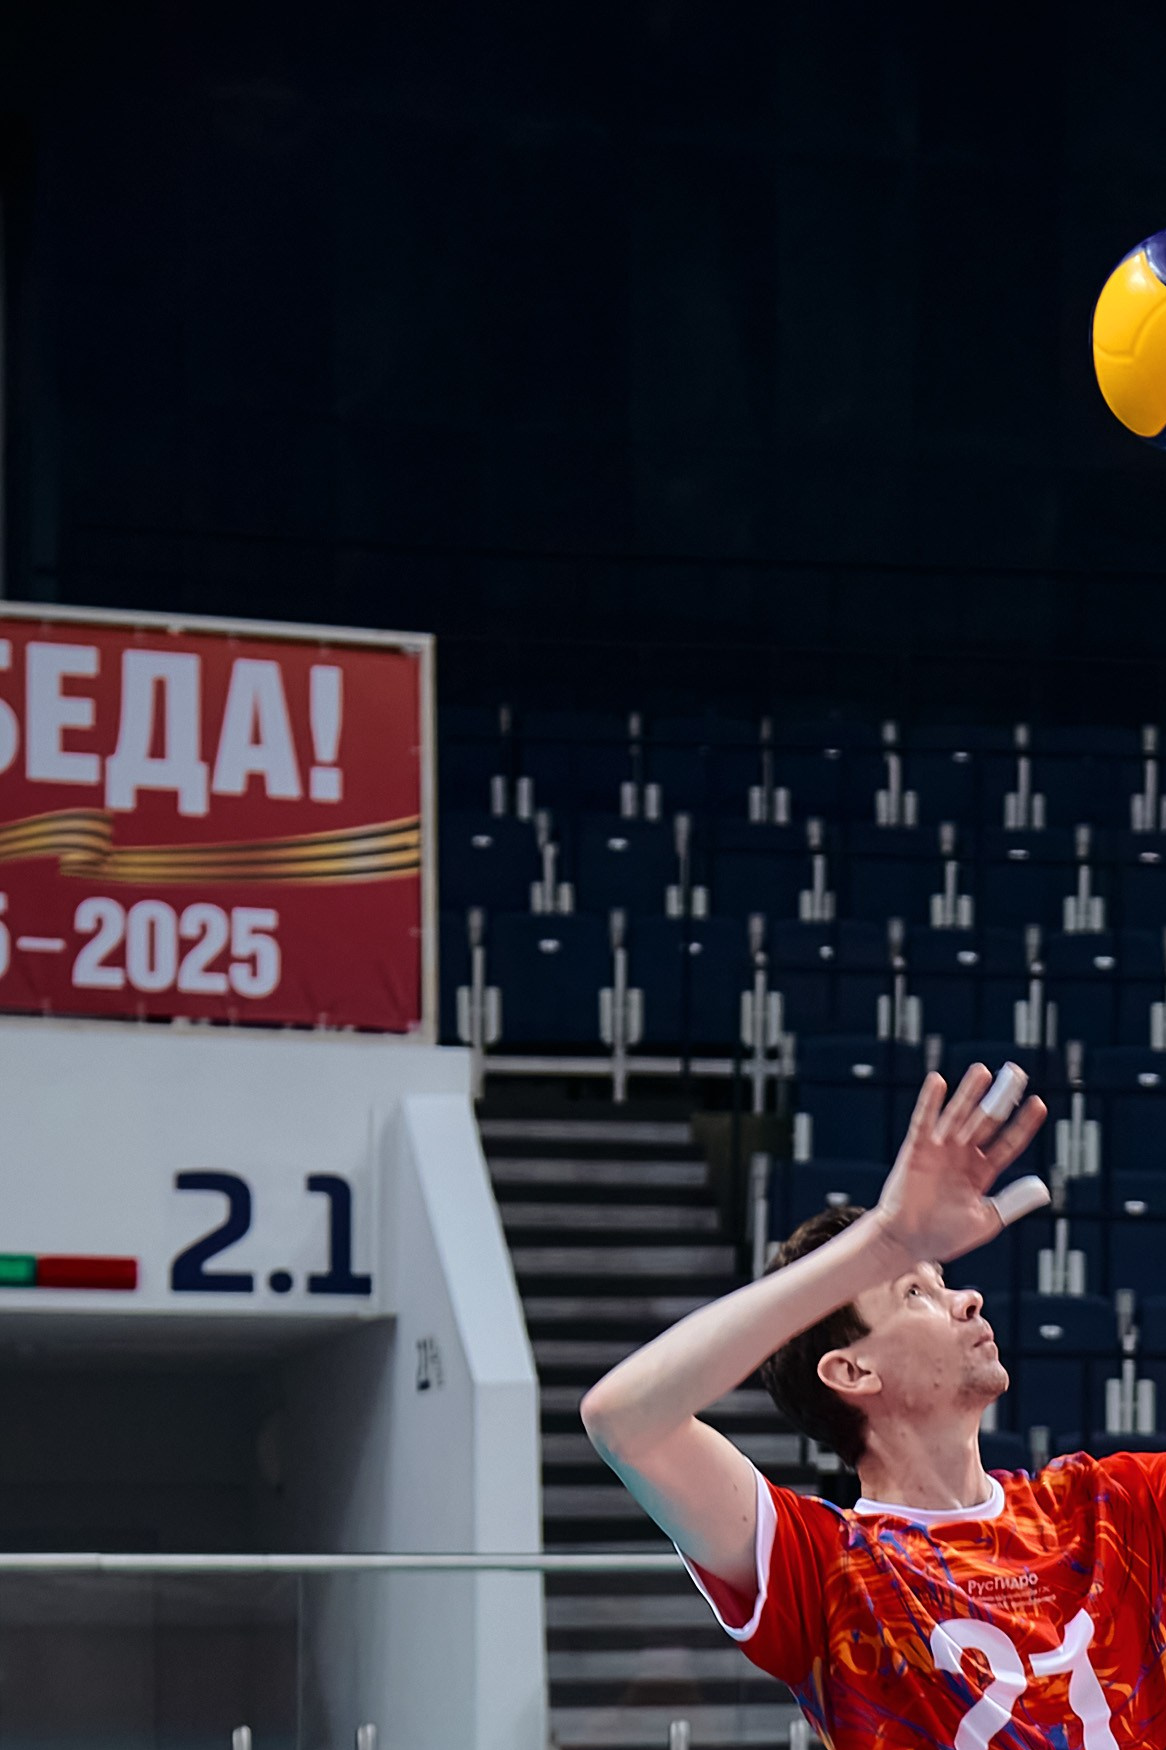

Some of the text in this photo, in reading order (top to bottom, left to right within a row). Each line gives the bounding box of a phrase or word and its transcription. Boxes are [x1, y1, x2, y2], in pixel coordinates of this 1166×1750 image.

[0, 638, 343, 818] ЕДА!
[0, 891, 281, 997] –2025
[170, 1169, 372, 1294] 2.1
